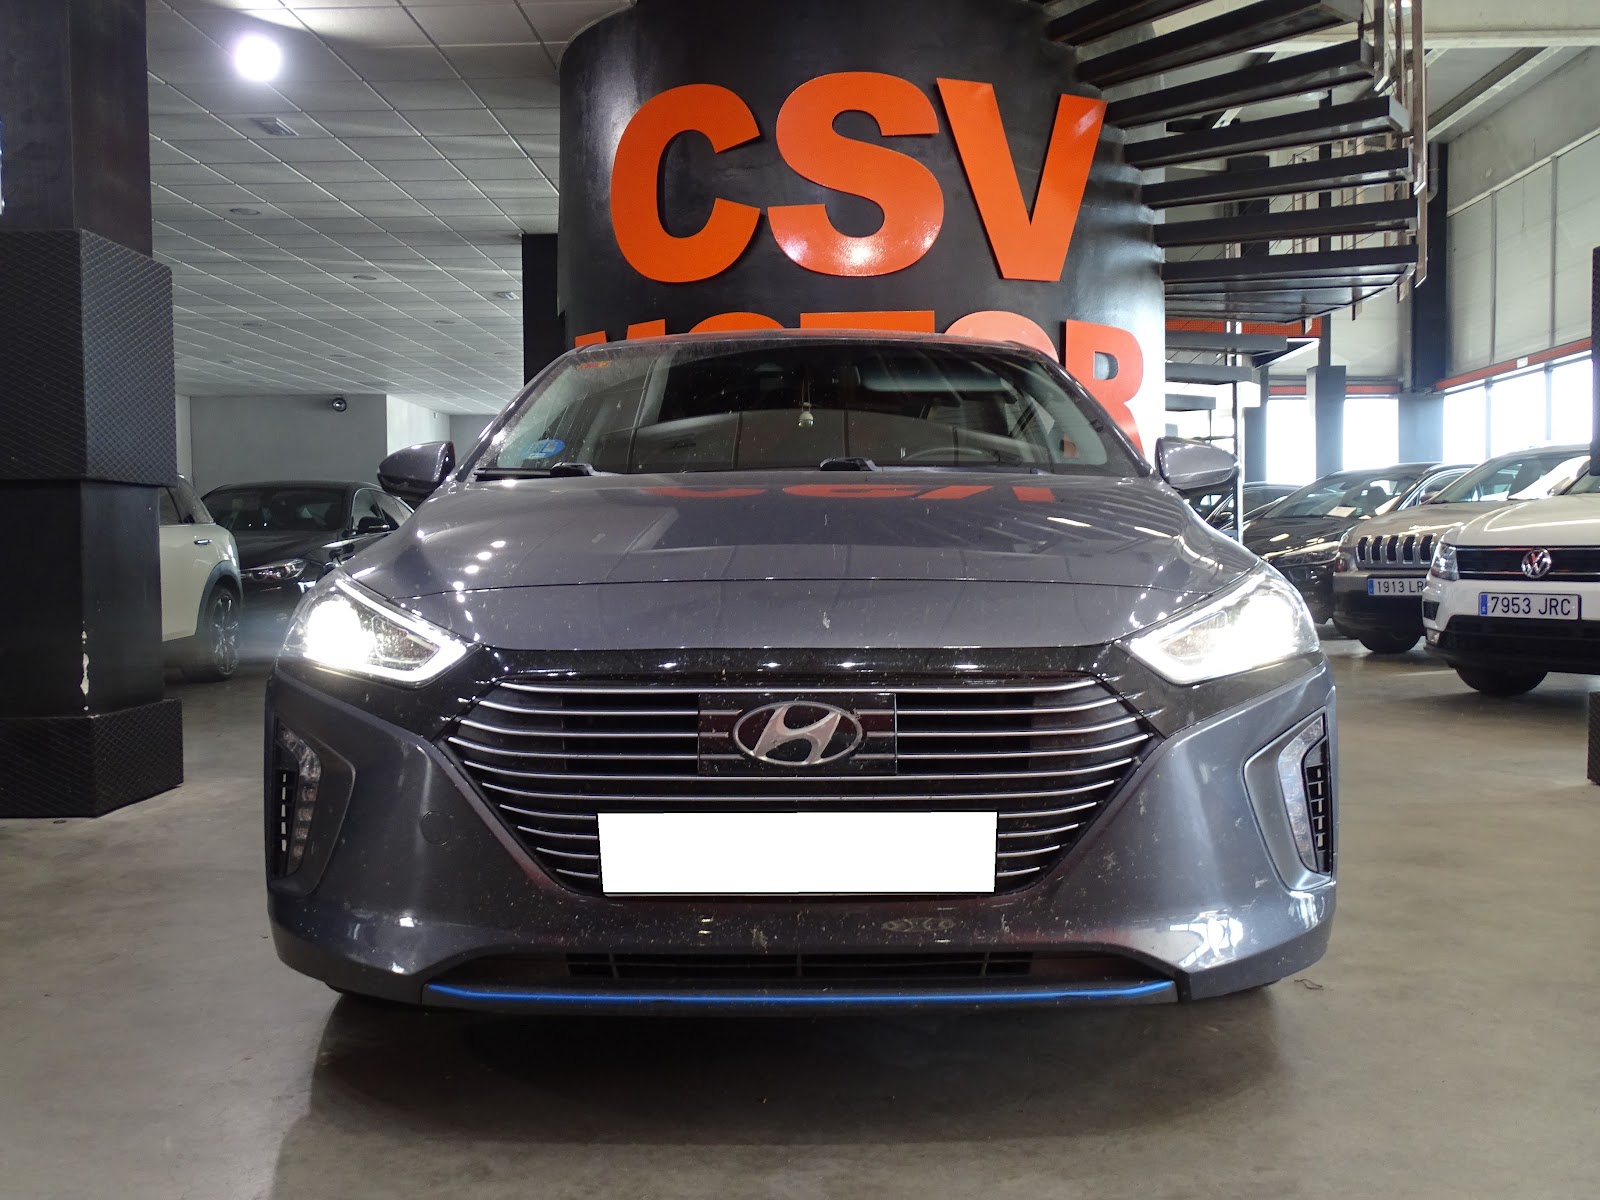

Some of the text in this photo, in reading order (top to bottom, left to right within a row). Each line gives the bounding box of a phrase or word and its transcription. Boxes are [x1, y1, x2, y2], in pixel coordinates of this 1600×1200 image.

[611, 71, 1107, 282] CSV
[1377, 581, 1427, 593] 1913 LR
[1491, 596, 1571, 616] 7953 JRC
